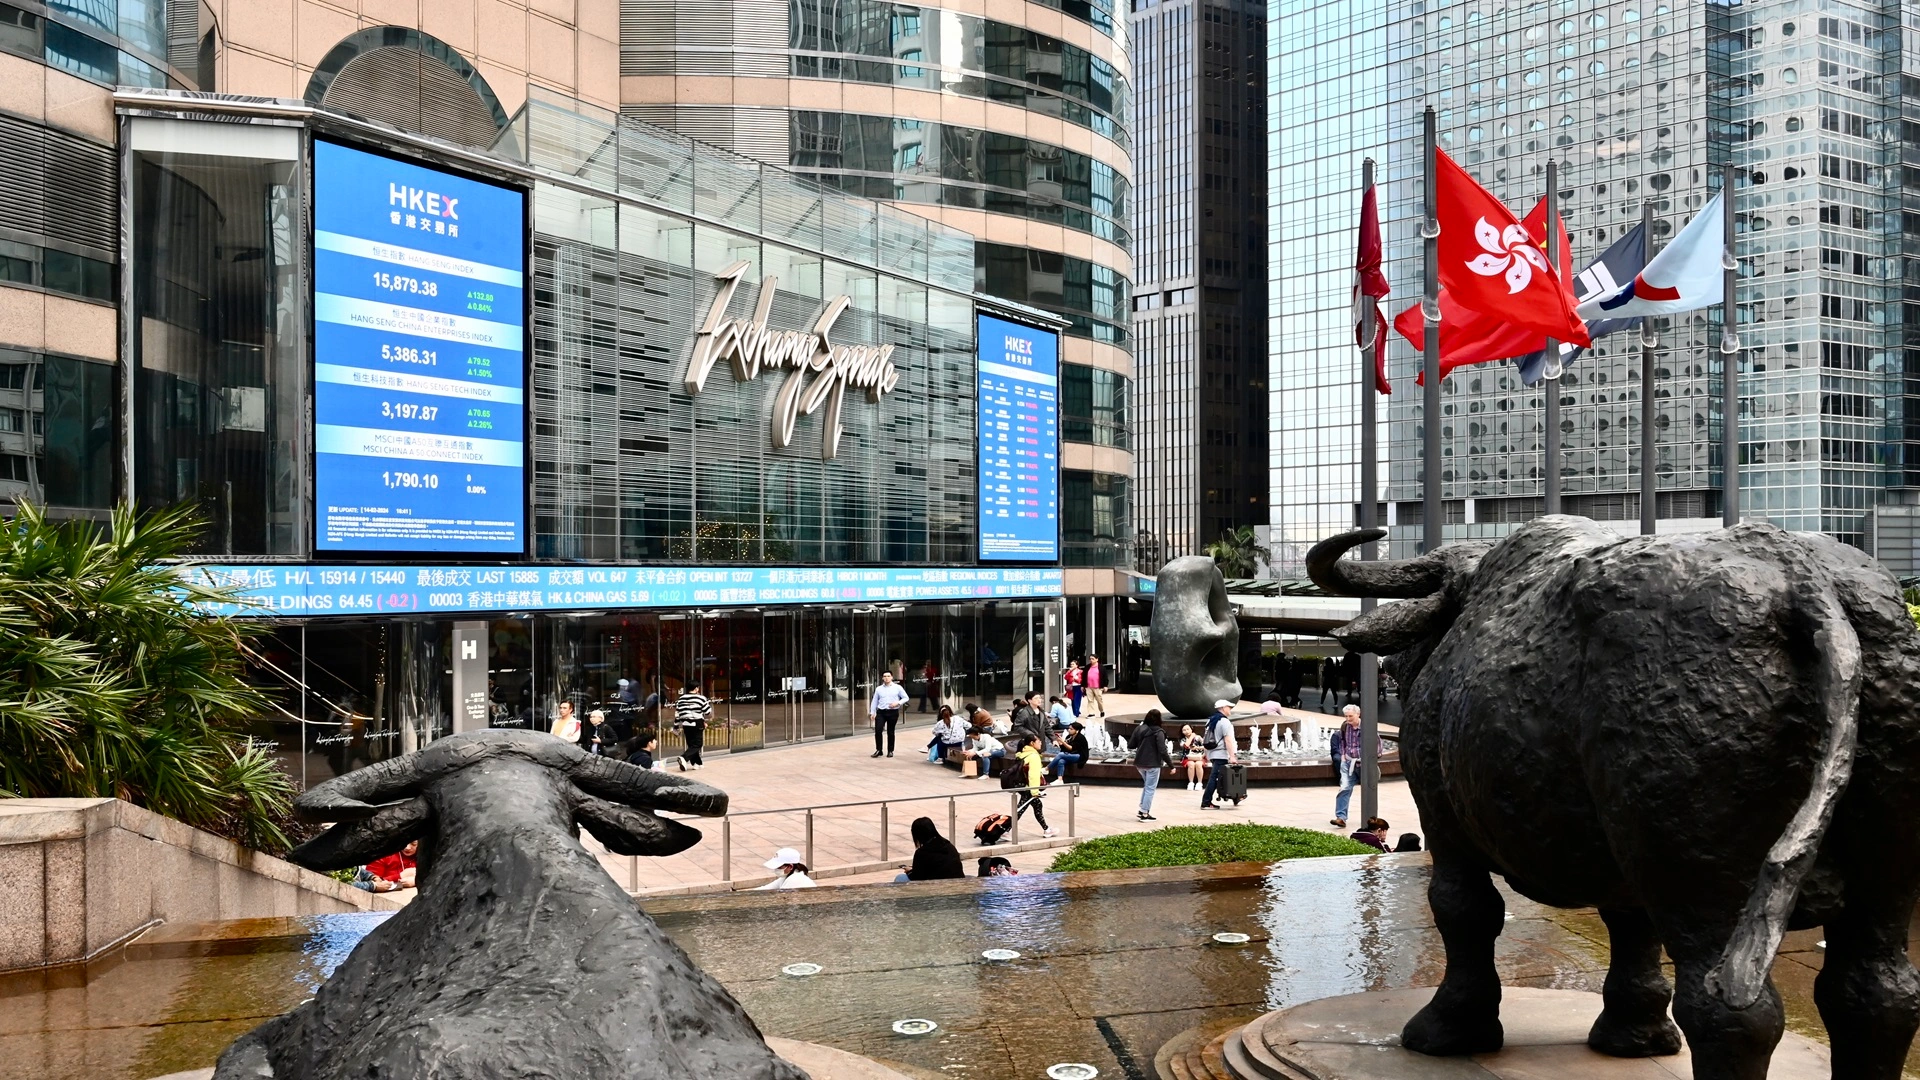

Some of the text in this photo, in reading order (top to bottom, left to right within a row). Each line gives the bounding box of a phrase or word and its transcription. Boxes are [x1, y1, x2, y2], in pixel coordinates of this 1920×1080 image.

[390, 182, 459, 221] HKEX
[390, 211, 459, 239] 香港交易所
[373, 246, 474, 274] 恒生指數 HANG SENG INDEX
[373, 271, 438, 297] 15,879.38
[392, 309, 456, 327] 恒生中國企業指數
[351, 314, 493, 343] HANG SENG CHINA ENTERPRISES INDEX
[382, 344, 437, 366] 5,386.31
[1005, 335, 1032, 355] HKEX
[353, 372, 492, 397] 恒生科技指數 HANG SENG TECH INDEX
[382, 401, 438, 422] 3,197.87
[363, 444, 383, 454] MSCI
[384, 446, 408, 455] CHINA
[426, 450, 460, 460] CONNECT
[462, 452, 484, 461] INDEX
[382, 471, 472, 490] 1,790.10 0
[466, 486, 487, 495] 0.00%
[286, 570, 314, 585] H/L
[320, 570, 356, 585] 15914
[370, 570, 406, 584] 15440
[417, 569, 472, 587] 最後成交
[476, 571, 505, 584] LAST
[510, 571, 540, 584] 15885
[588, 571, 608, 583] VOL
[610, 571, 627, 583] 647
[635, 570, 686, 585] 未平倉合約
[690, 571, 714, 583] OPEN
[239, 594, 332, 610] HOLDINGS
[339, 594, 372, 608] 64.45
[429, 593, 463, 607] 00003
[468, 590, 544, 608] 香港中華煤氣
[548, 592, 562, 604] HK
[574, 592, 606, 604] CHINA
[606, 591, 627, 604] GAS
[461, 640, 477, 660] H
